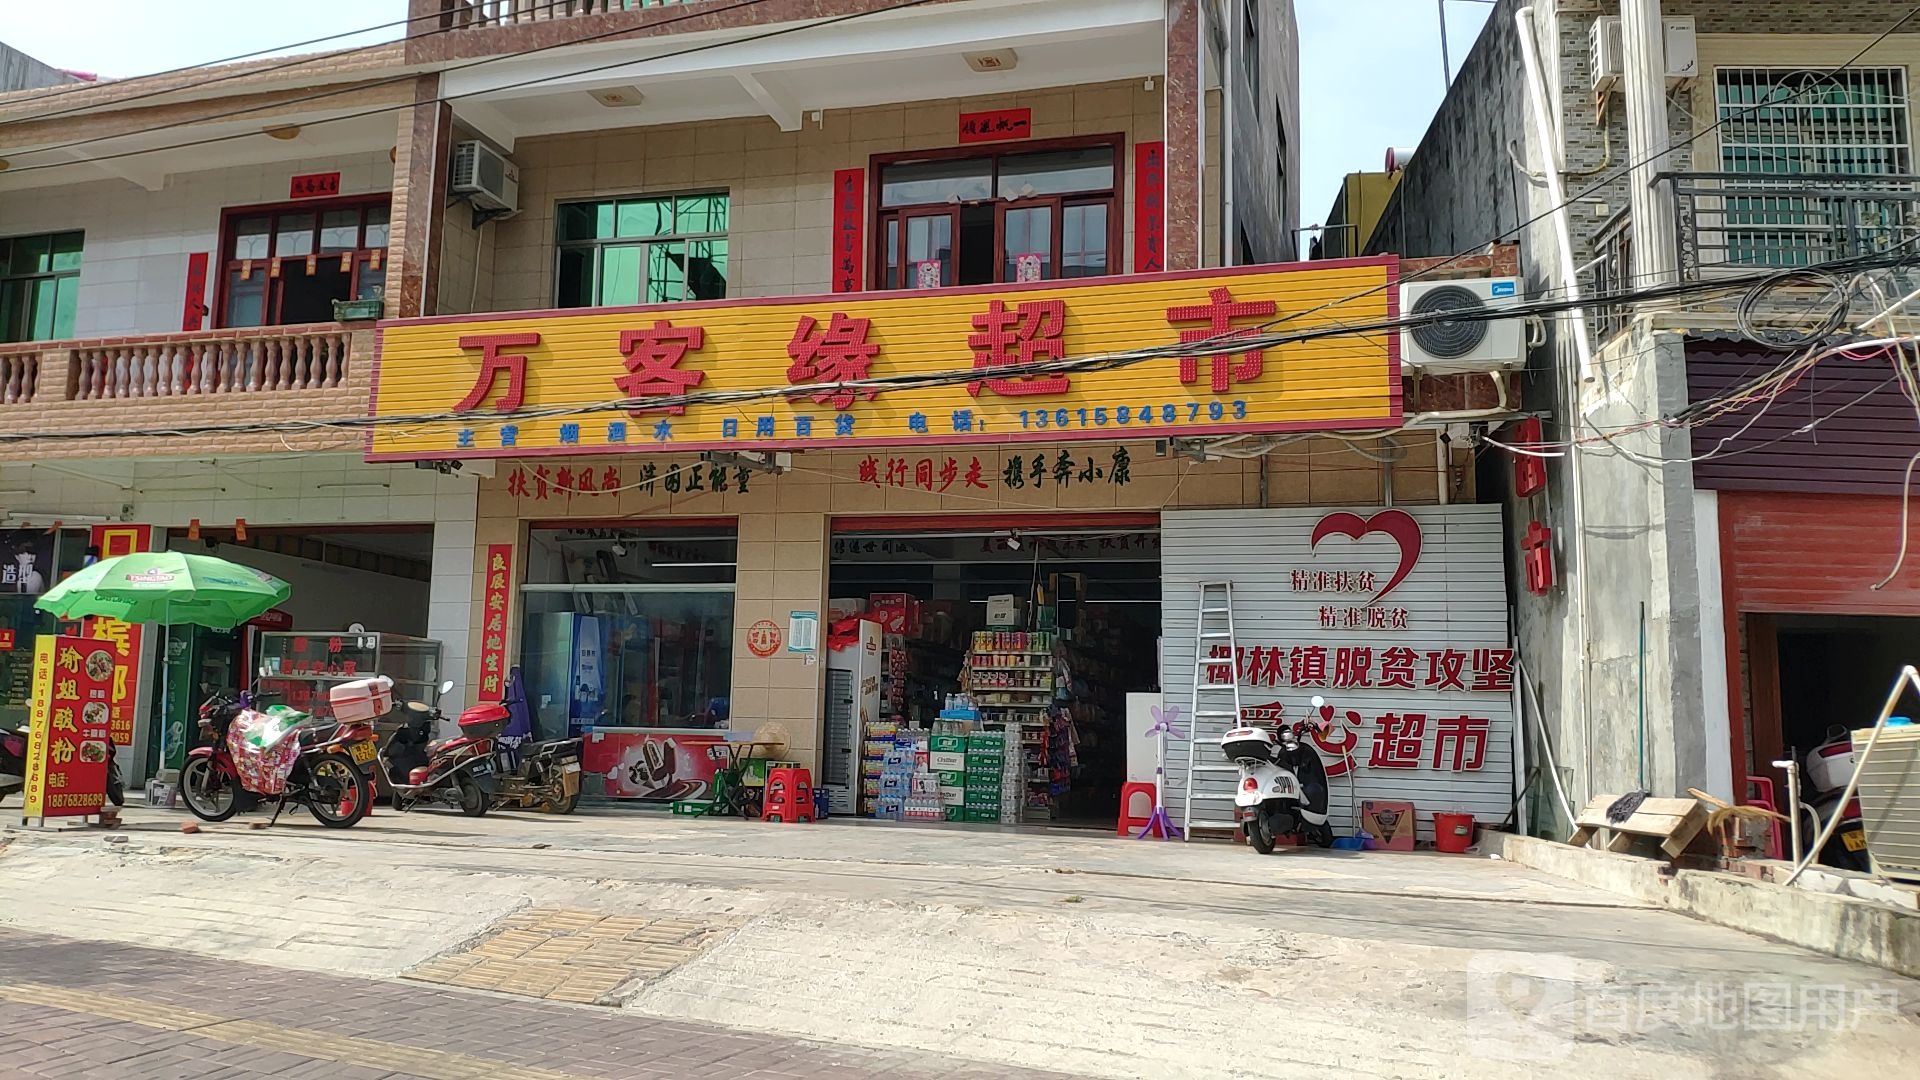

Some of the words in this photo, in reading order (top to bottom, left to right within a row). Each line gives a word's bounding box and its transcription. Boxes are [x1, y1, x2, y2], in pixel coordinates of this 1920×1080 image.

[452, 286, 1277, 416] 万客缘超市
[456, 425, 519, 448] 主营
[560, 420, 673, 443] 烟酒水
[722, 414, 855, 437] 日用百货
[1020, 400, 1247, 428] 13615848793
[858, 454, 989, 493] 践行同步走
[1003, 445, 1131, 490] 携手奔小康
[1290, 569, 1376, 593] 精准扶贫
[1318, 605, 1410, 629] 精准脱贫
[1206, 644, 1515, 691] 椰林镇脱贫攻坚
[50, 645, 84, 764] 瑜姐酸粉
[47, 793, 103, 808] 18876828689
